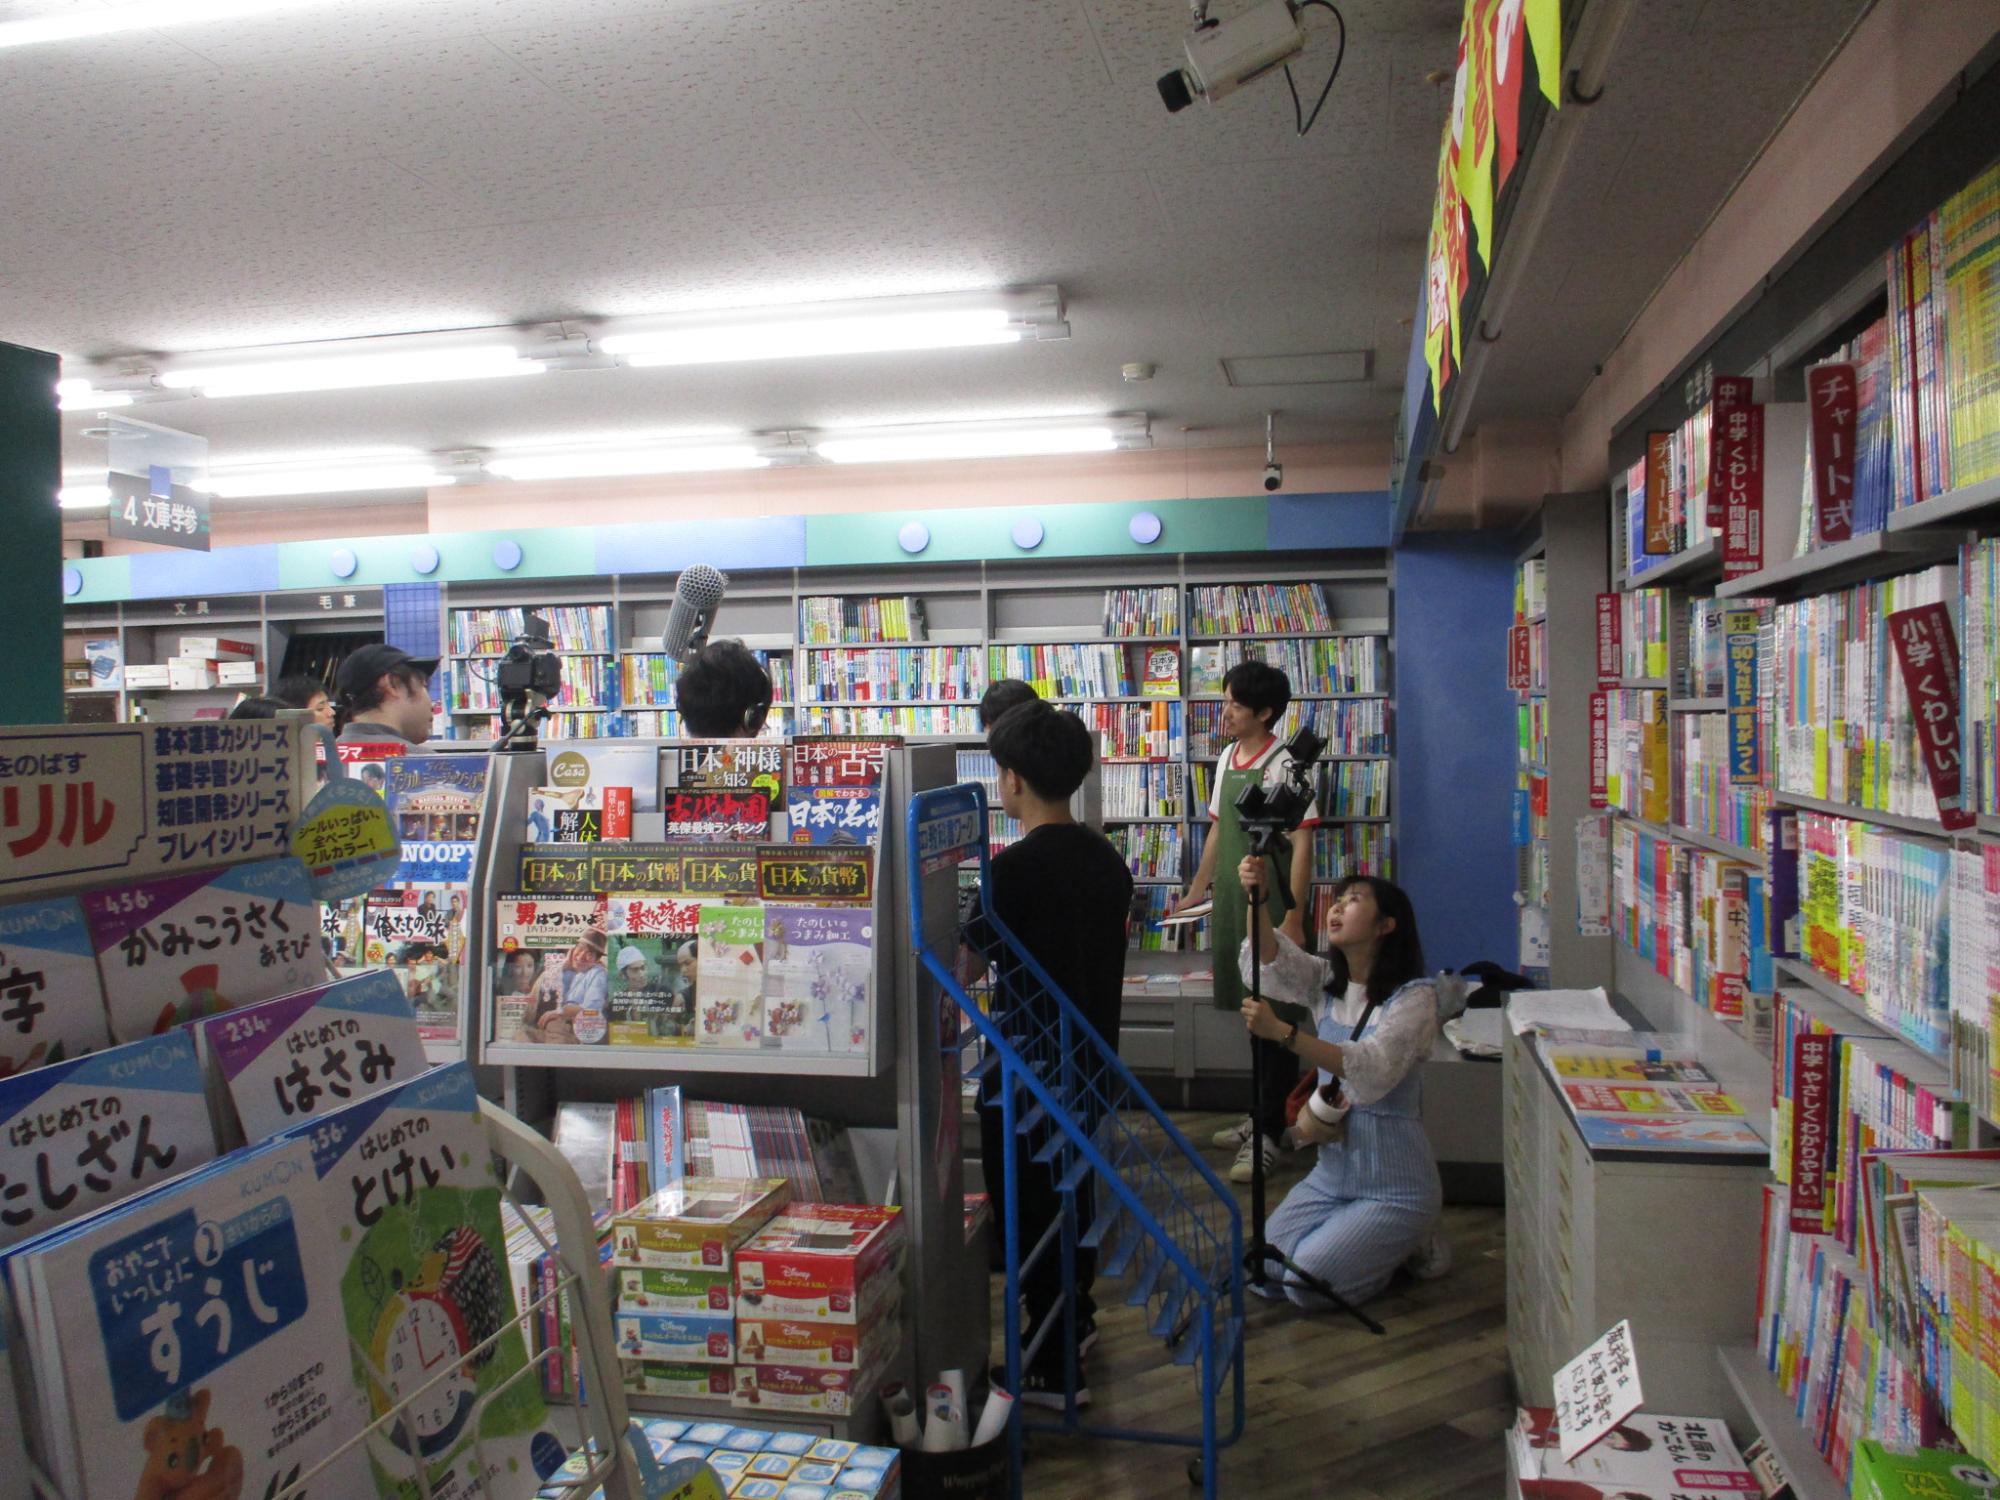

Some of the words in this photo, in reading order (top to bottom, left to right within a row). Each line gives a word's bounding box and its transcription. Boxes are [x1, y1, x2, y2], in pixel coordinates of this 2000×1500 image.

[1817, 375, 1852, 532] チャート式
[1650, 440, 1671, 545] チャート式
[124, 496, 138, 526] 4
[143, 498, 198, 534] 文庫学参
[1518, 630, 1529, 687] チャート式
[553, 762, 586, 778] Casa
[681, 746, 782, 773] 日本の神様
[713, 772, 748, 787] を知る
[313, 825, 360, 850] 全ページ
[600, 862, 679, 882] 日本の貨幣
[770, 866, 859, 886] 日本の貨幣
[373, 908, 447, 944] 俺たちの旅
[516, 902, 597, 925] 男はつらいよ
[120, 899, 289, 967] かみこうさく
[260, 933, 311, 968] あそび
[791, 928, 851, 941] つまみ細工
[286, 1019, 360, 1055] はじめての
[274, 1040, 396, 1116] はさみ
[9, 1096, 121, 1148] はじめての
[1798, 1041, 1824, 1197] 中学やさしくわかりやすい
[360, 1116, 430, 1160] はじめての
[350, 1145, 455, 1228] とけい
[654, 1228, 682, 1242] Disney
[104, 1235, 173, 1287] おやこで
[781, 1265, 810, 1280] Disney
[111, 1257, 193, 1316] いっしょに
[661, 1272, 689, 1286] Disney
[140, 1257, 278, 1385] すうじ
[658, 1320, 687, 1333] Disney
[781, 1324, 811, 1339] Disney
[774, 1368, 804, 1384] Disney
